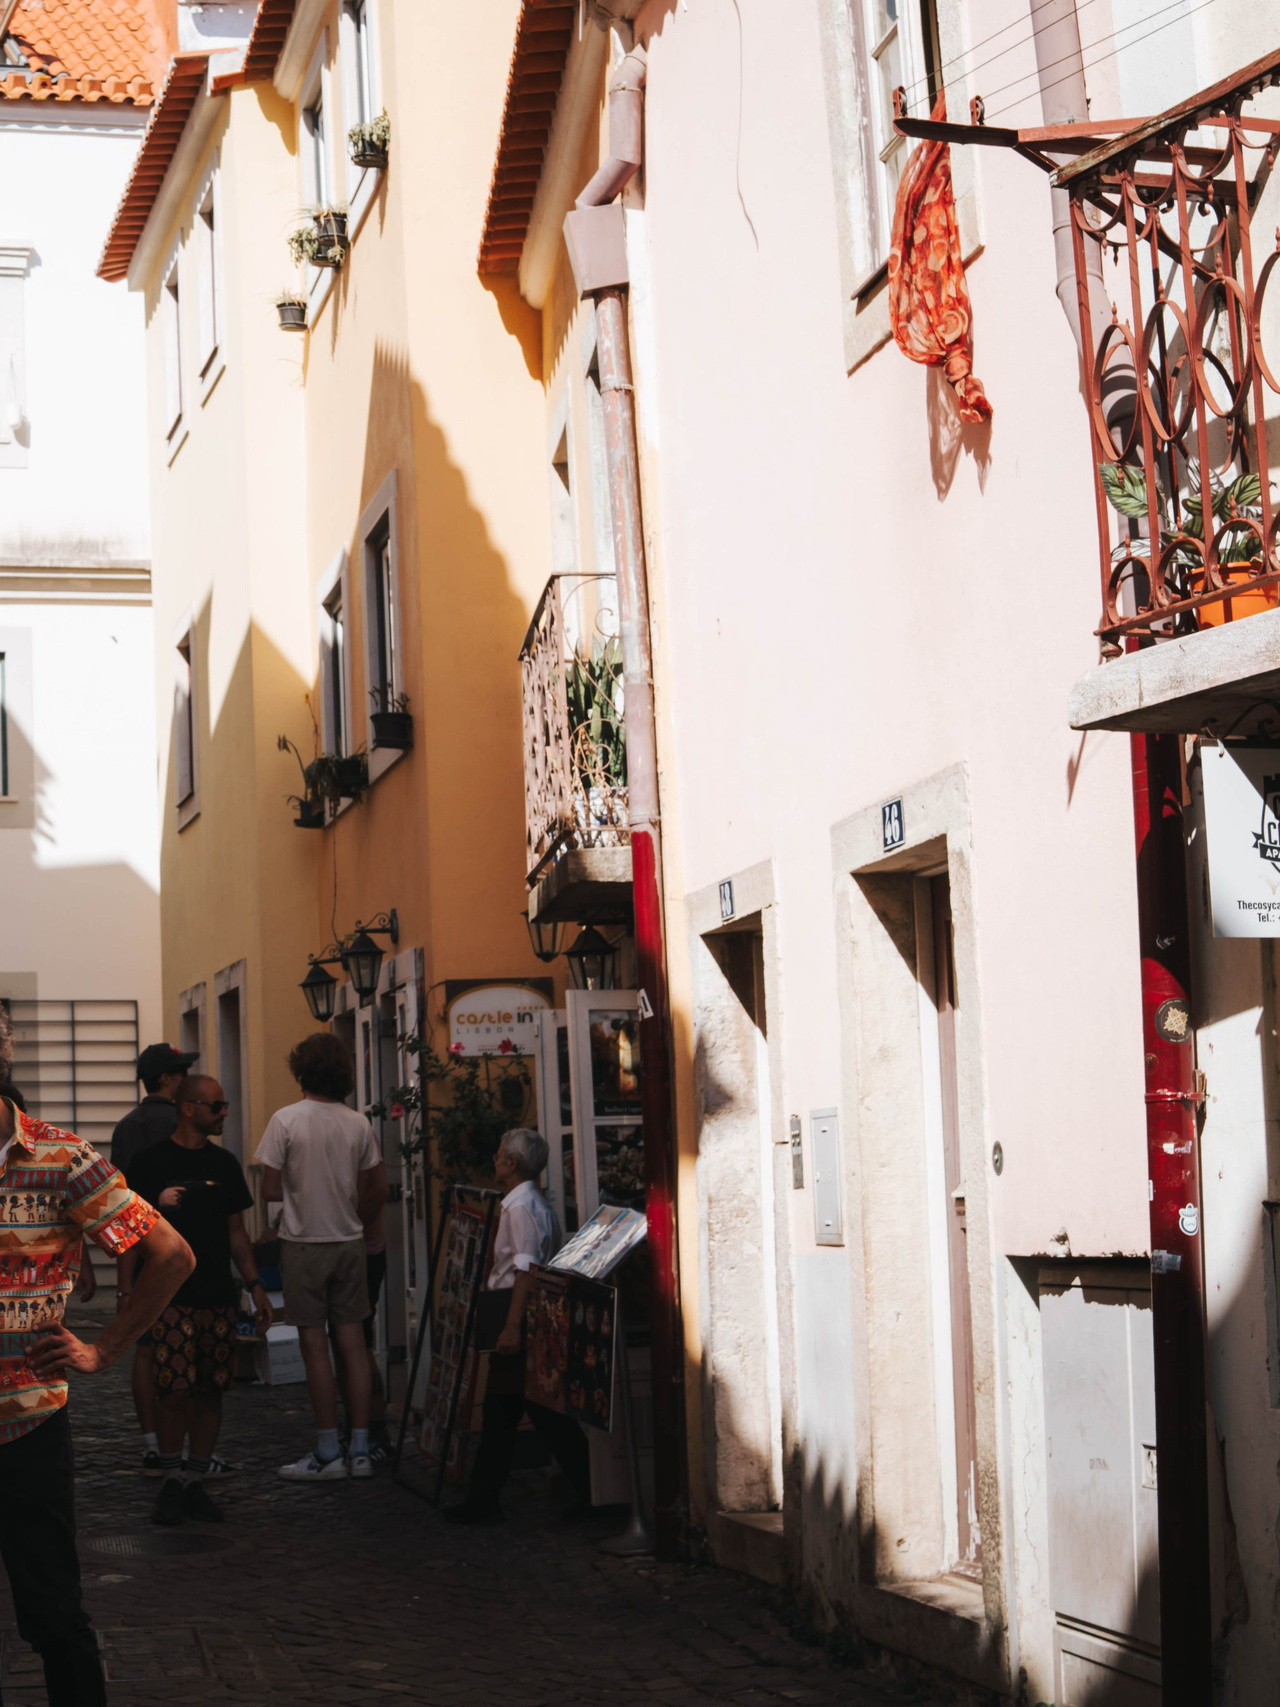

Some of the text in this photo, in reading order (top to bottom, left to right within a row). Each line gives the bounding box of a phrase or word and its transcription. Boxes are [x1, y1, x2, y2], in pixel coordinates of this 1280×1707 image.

[884, 804, 900, 845] 46
[720, 883, 732, 917] 48
[456, 1010, 513, 1025] castle
[456, 1027, 514, 1035] LISBON
